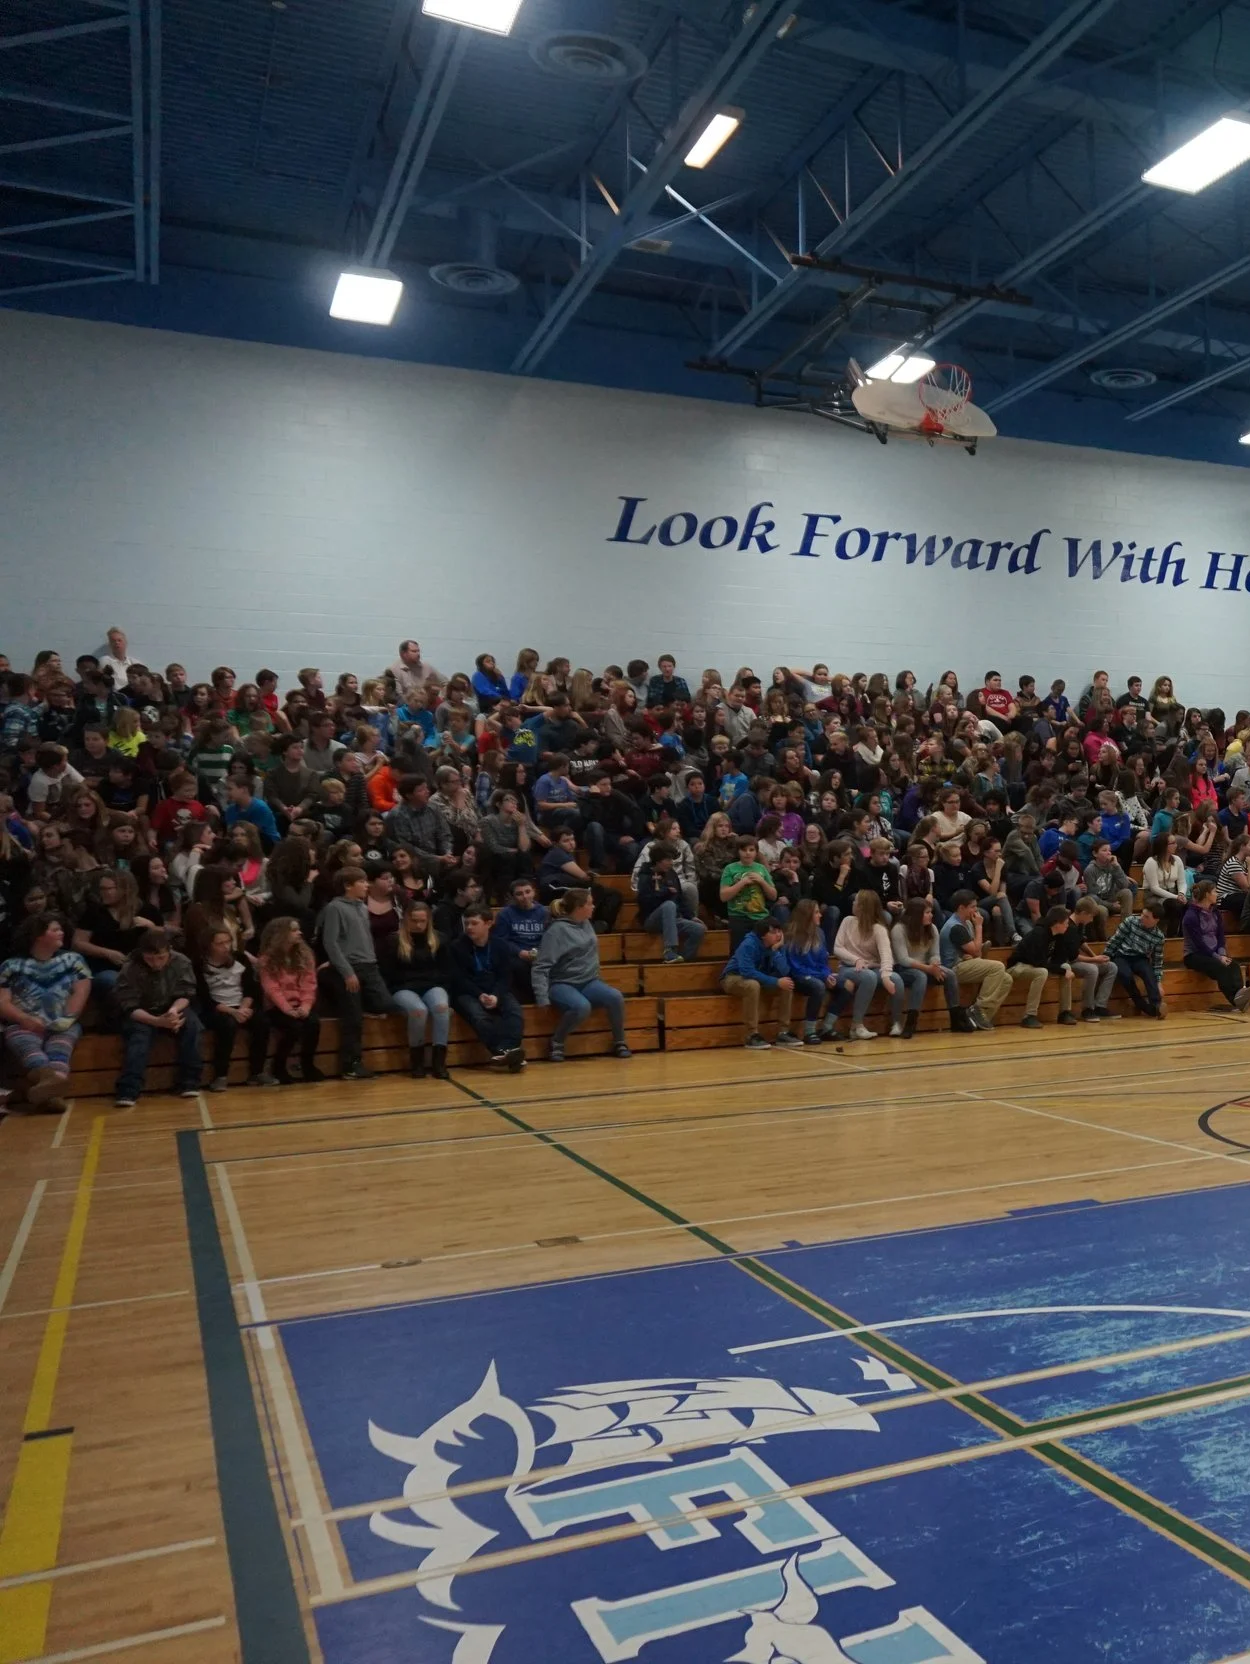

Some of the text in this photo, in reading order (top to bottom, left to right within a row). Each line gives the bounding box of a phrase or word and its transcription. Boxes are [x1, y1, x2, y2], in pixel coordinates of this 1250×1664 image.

[605, 496, 778, 553] Look
[791, 513, 1051, 575] Forward
[1063, 538, 1188, 587] With
